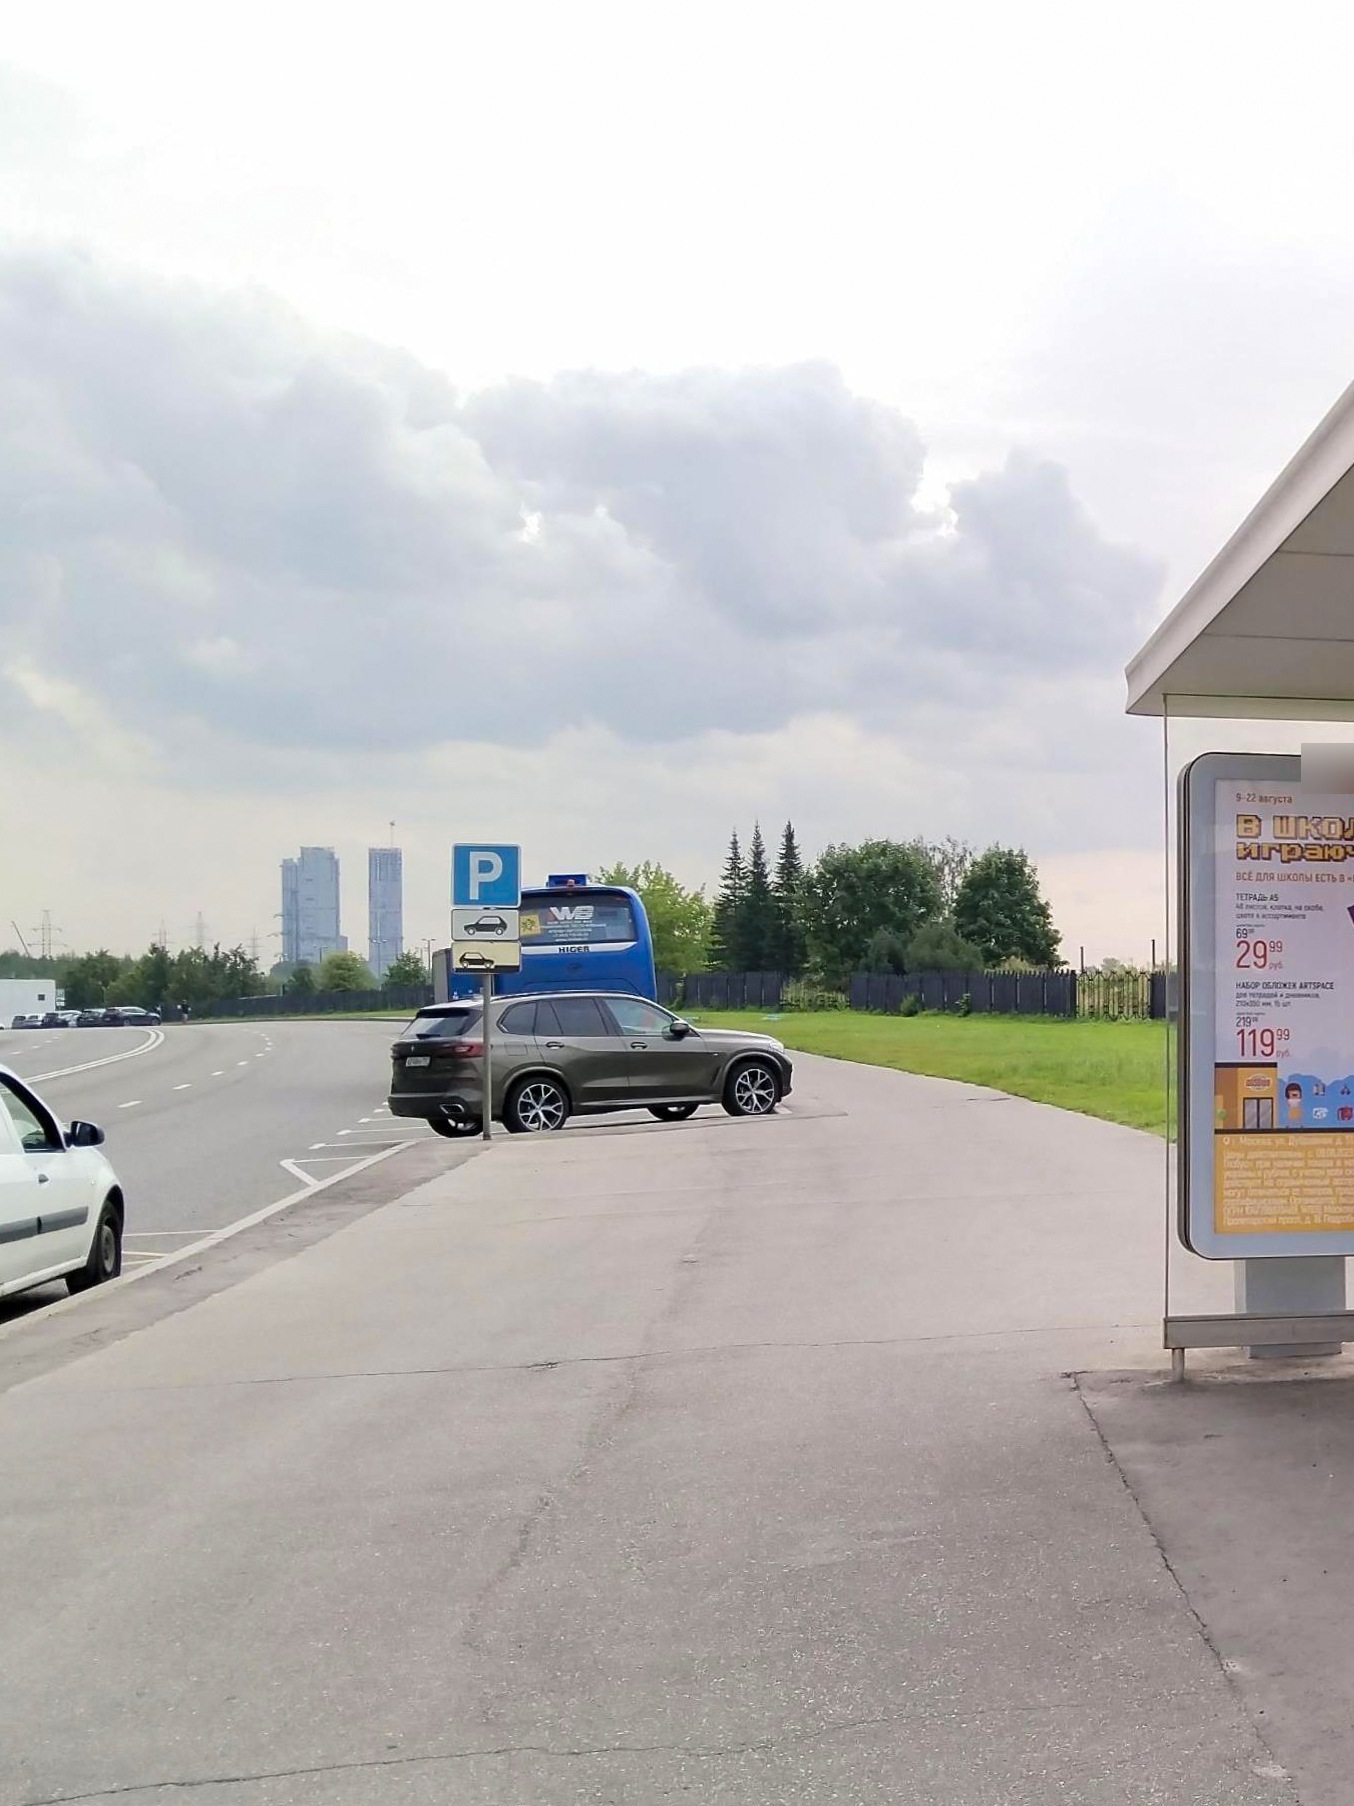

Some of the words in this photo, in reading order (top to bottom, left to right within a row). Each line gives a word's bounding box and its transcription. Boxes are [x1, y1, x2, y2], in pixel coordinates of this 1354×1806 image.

[1258, 794, 1293, 805] августа
[1236, 814, 1262, 838] В
[469, 851, 503, 900] P
[1255, 872, 1275, 883] ДЛЯ
[1276, 872, 1313, 883] ШКОЛЫ
[1315, 873, 1338, 883] ЕСТЬ
[1339, 873, 1346, 883] В
[1235, 893, 1268, 902] ТЕТРАДЬ
[1235, 928, 1248, 939] 69
[1236, 940, 1268, 969] 29
[1269, 941, 1283, 953] 99
[1236, 1028, 1275, 1057] 119
[1276, 1029, 1290, 1040] 99
